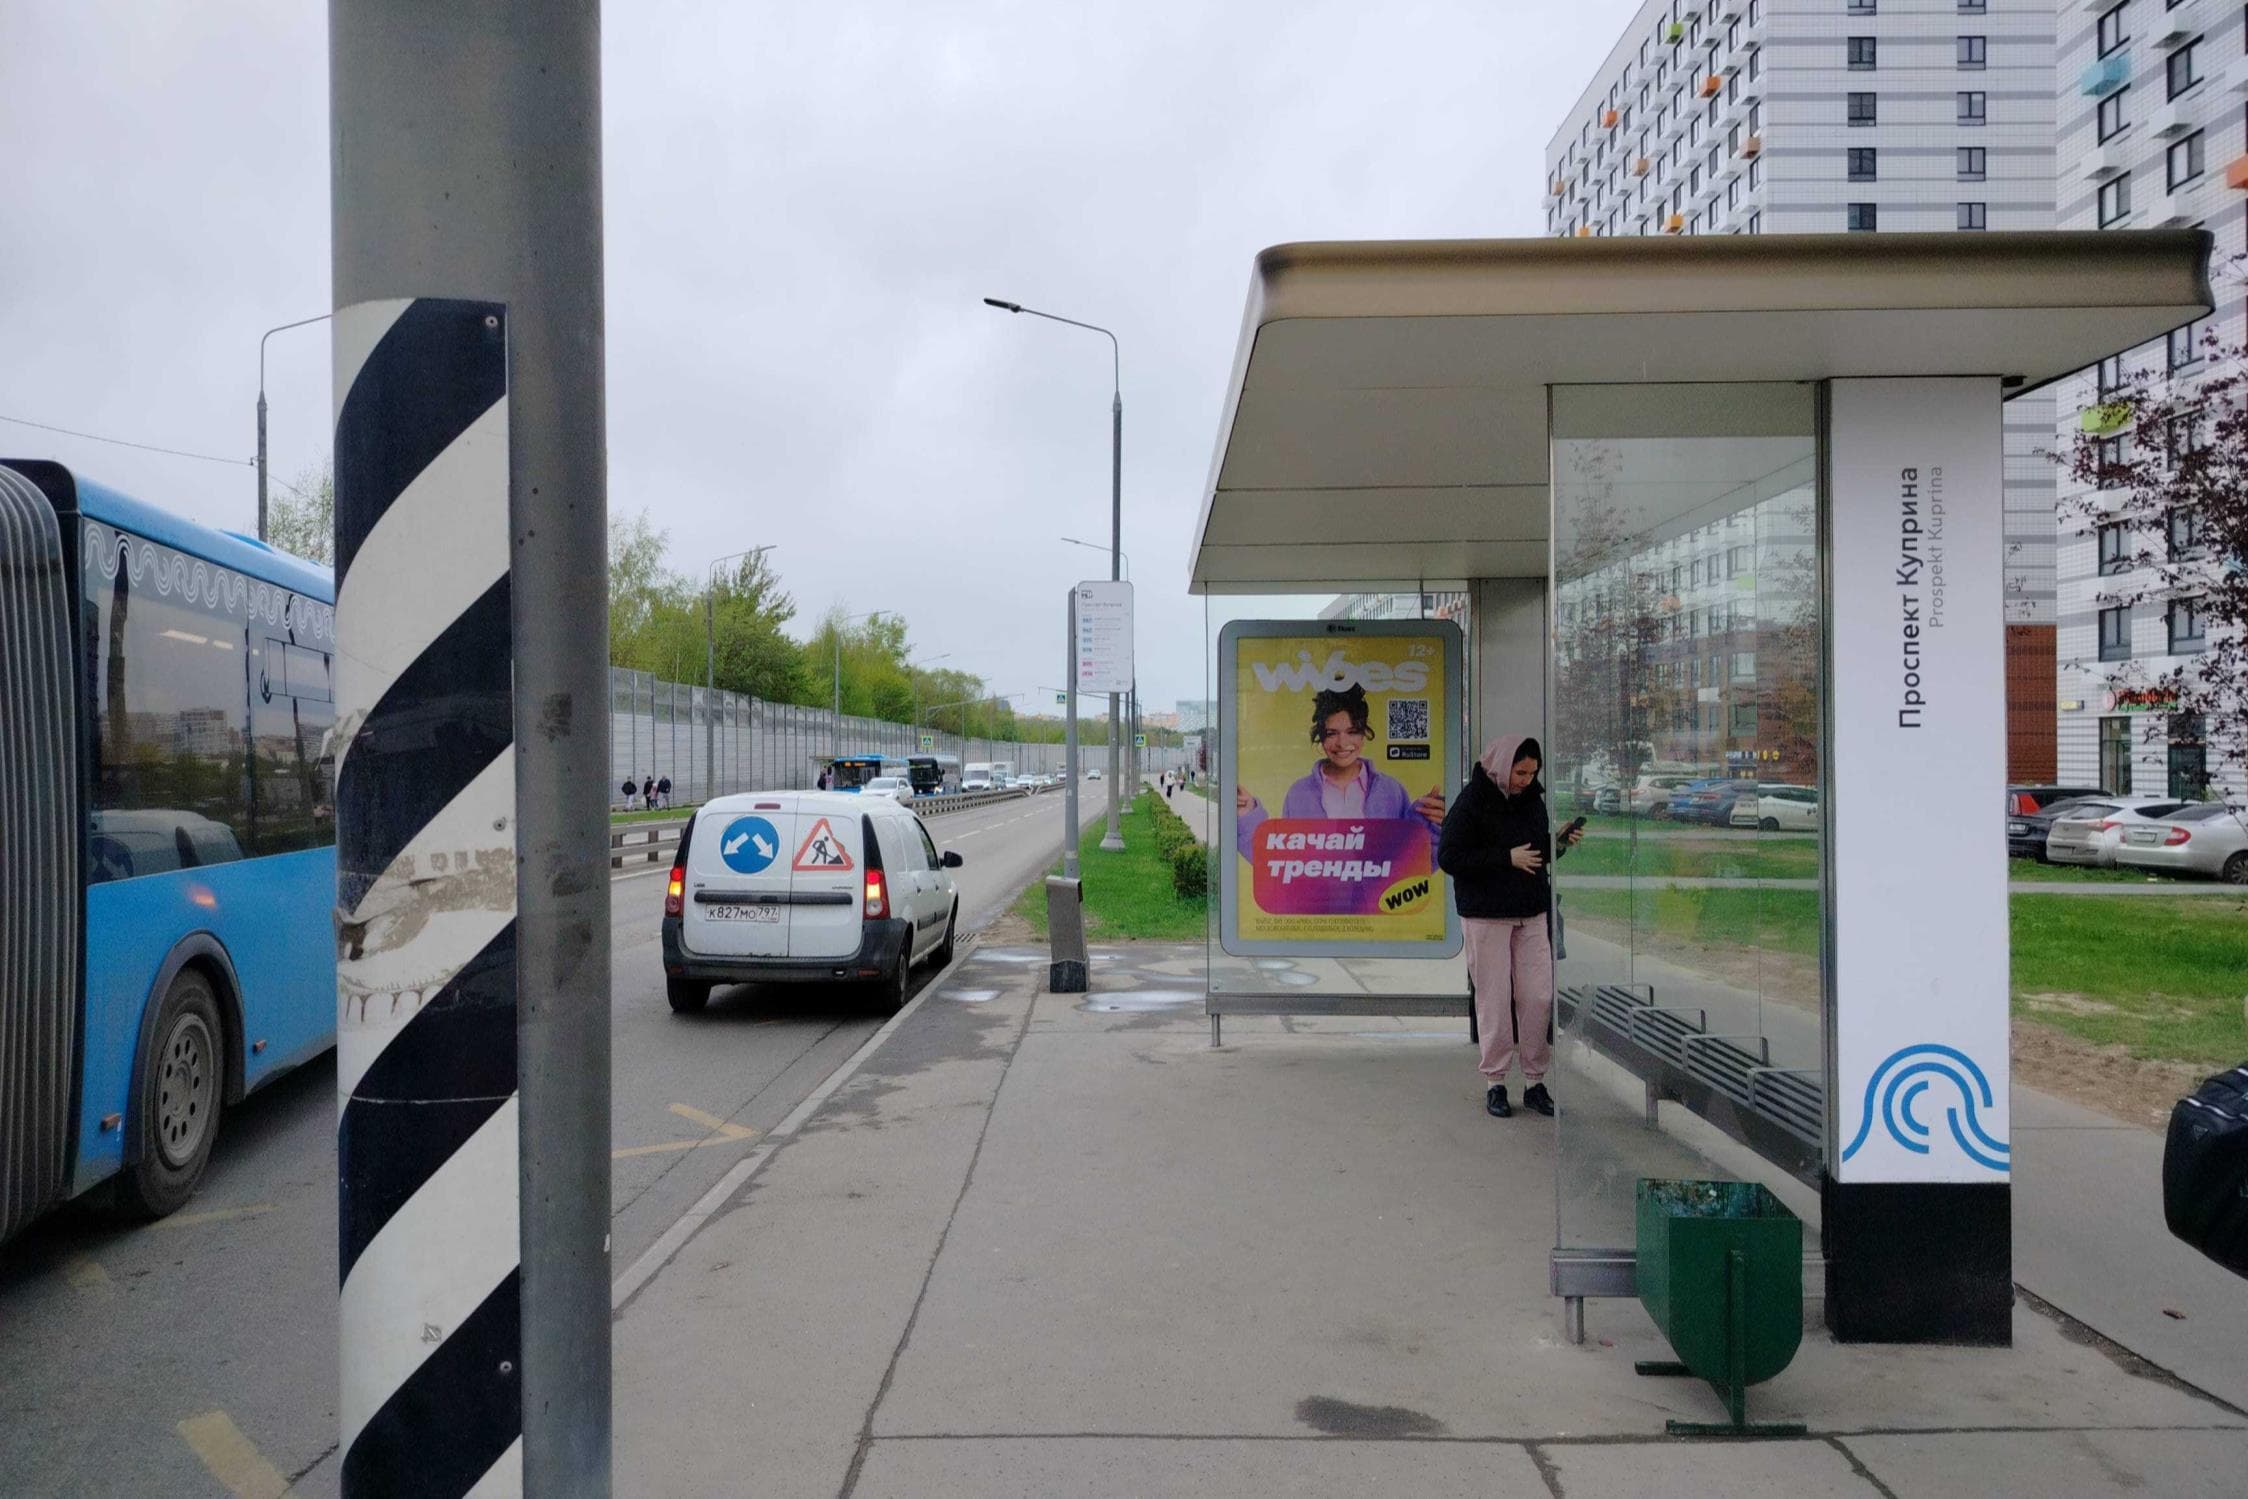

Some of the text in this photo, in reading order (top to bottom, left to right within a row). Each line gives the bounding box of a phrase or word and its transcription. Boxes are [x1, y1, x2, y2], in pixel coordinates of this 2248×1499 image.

[1927, 466, 1947, 628] Prospekt Kuprina
[1896, 467, 1926, 728] Проспект Куприна
[1266, 825, 1365, 850] качай
[1267, 860, 1391, 884] тренды
[758, 906, 777, 917] 797
